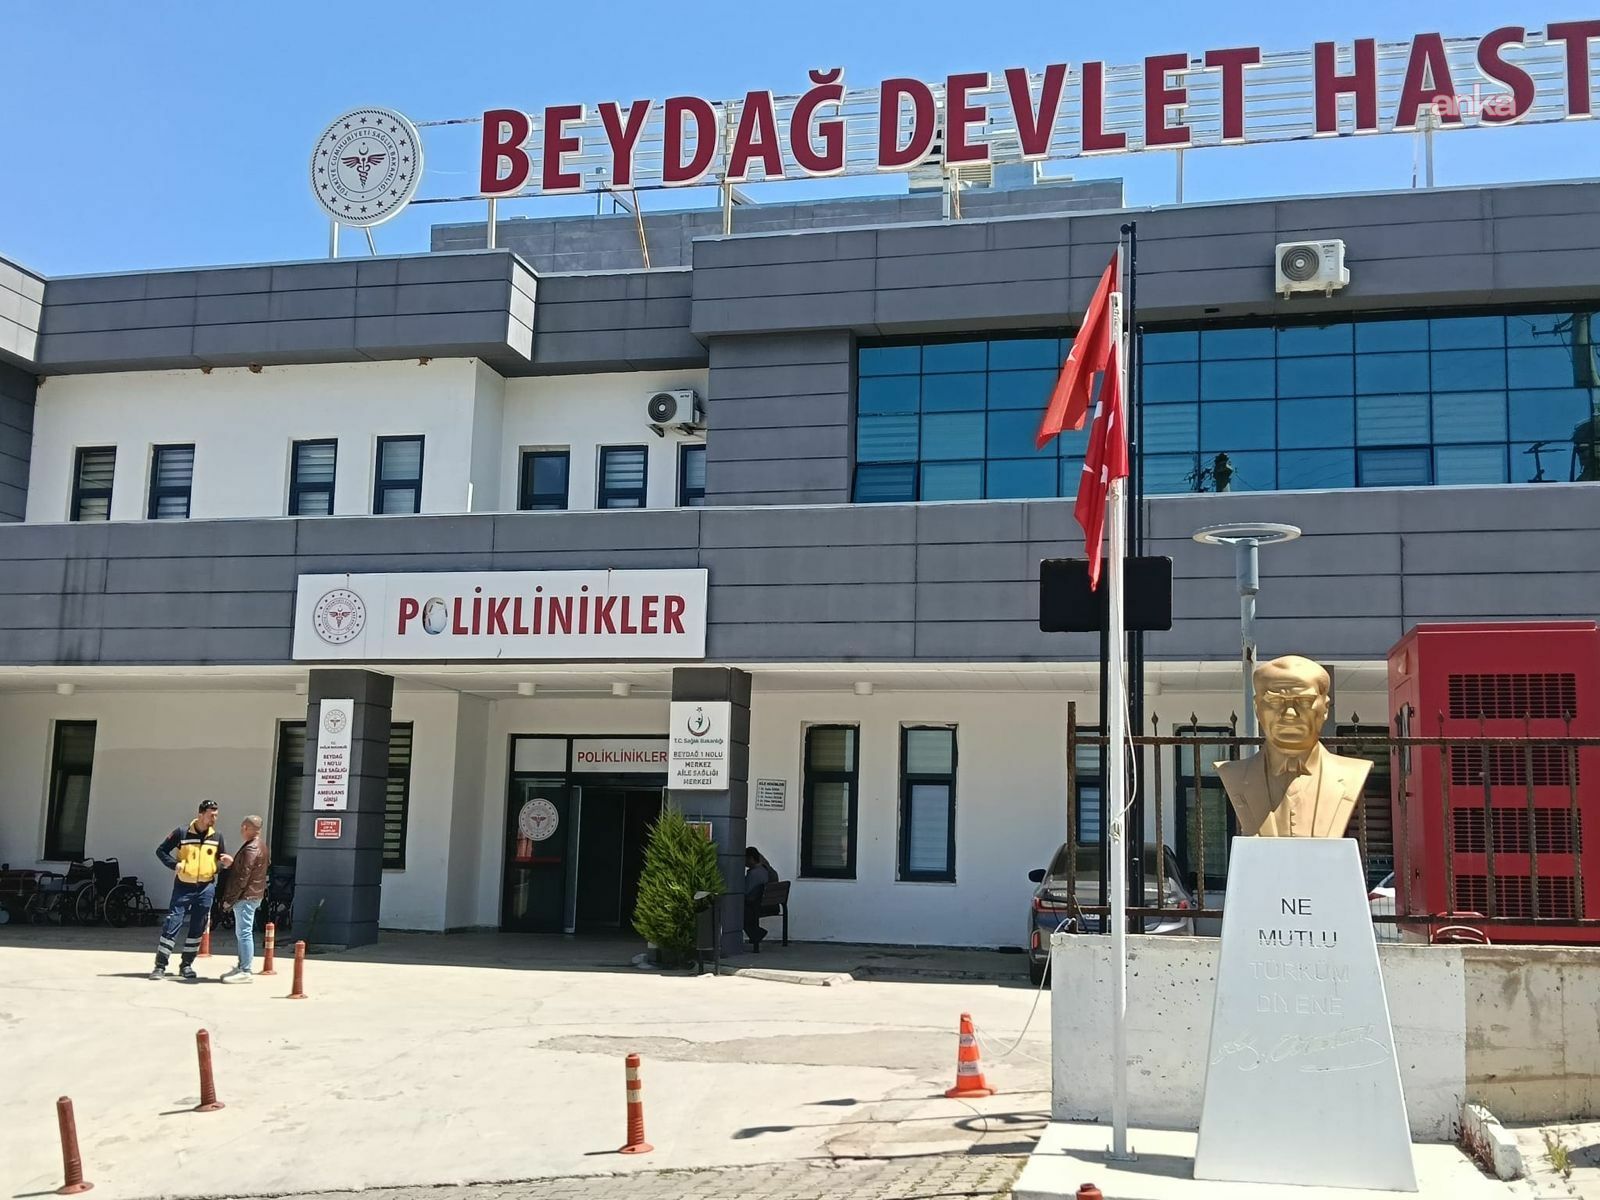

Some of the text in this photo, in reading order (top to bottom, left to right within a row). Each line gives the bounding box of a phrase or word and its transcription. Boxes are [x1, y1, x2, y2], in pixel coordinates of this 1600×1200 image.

[480, 20, 1600, 197] BEYDAĞ DEVLET HAST
[331, 129, 370, 166] CUMHURİYETİ
[372, 130, 394, 150] SAĞLIK
[577, 748, 668, 763] POLİKLİNİKLER
[673, 750, 699, 758] BEYDAĞ
[693, 769, 719, 777] SAĞLIĞI
[1281, 898, 1312, 915] NE
[1258, 929, 1337, 948] MUTLU
[1249, 960, 1350, 982] TÜRKÜM
